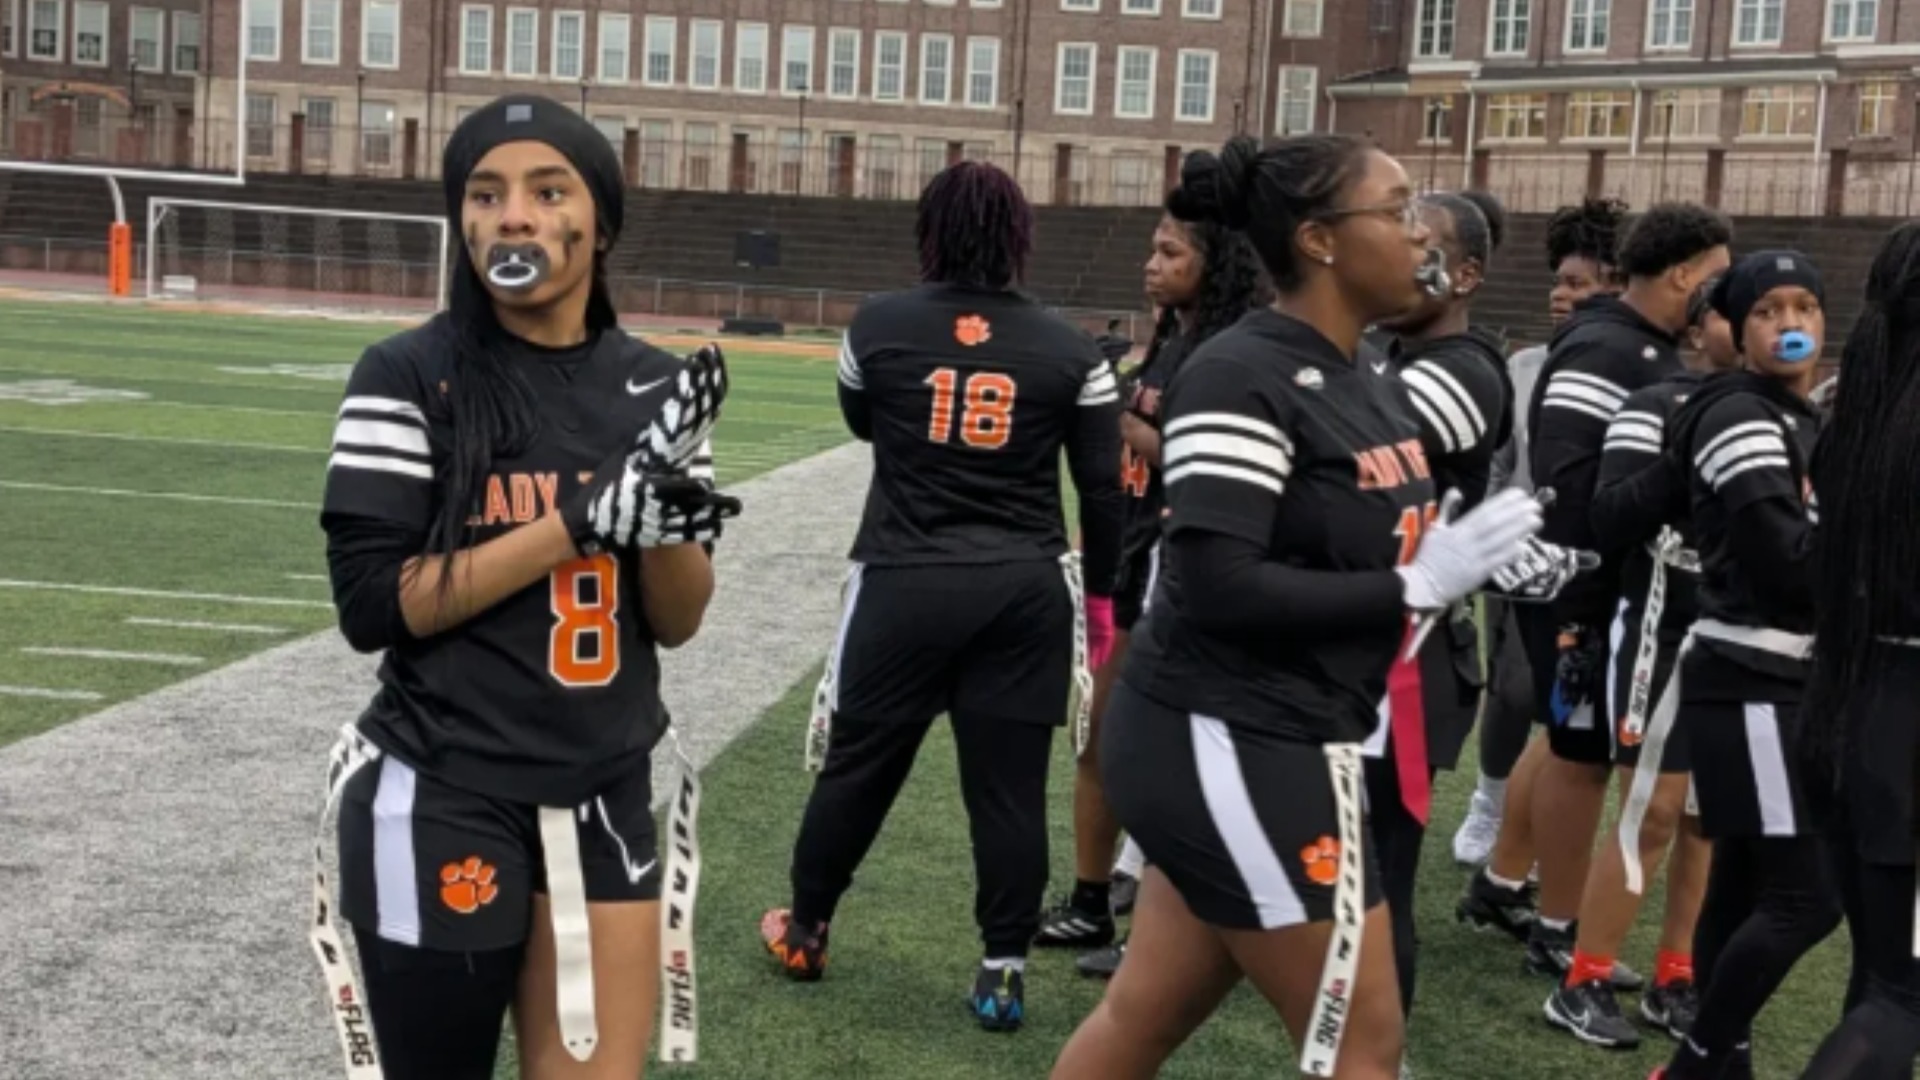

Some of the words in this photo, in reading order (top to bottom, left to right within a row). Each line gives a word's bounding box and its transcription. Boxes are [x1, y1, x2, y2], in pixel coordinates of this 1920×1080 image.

[924, 366, 1016, 449] 18
[466, 470, 559, 525] ADY
[548, 553, 620, 688] 8
[336, 1003, 375, 1067] FLAG
